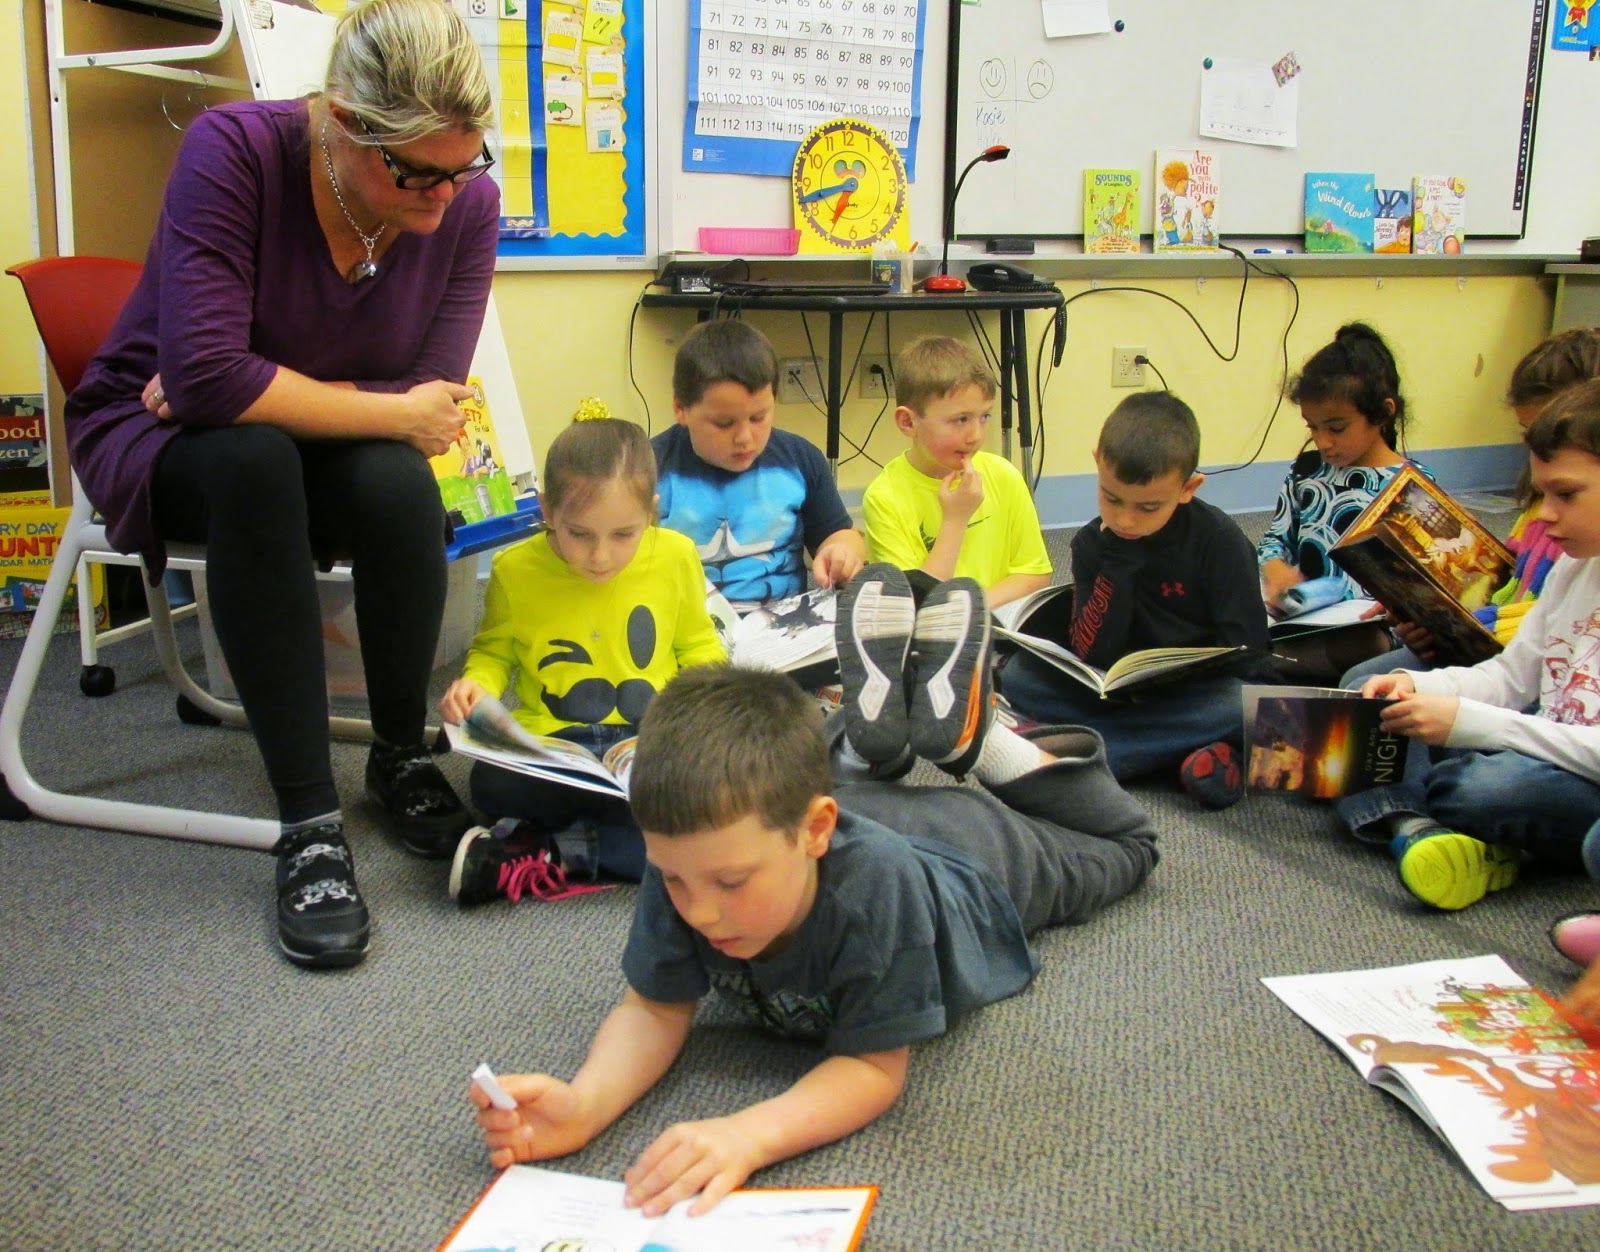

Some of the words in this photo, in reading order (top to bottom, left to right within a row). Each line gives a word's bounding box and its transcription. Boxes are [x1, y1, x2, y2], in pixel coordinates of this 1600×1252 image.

[842, 0, 852, 11] 67
[862, 3, 875, 13] 68
[884, 4, 896, 14] 69
[904, 6, 916, 17] 70
[710, 13, 721, 23] 71
[732, 15, 744, 26] 72
[754, 17, 767, 28] 73
[775, 20, 788, 31] 74
[798, 21, 811, 33] 75
[820, 23, 832, 35] 76
[842, 25, 853, 36] 77
[862, 28, 874, 39] 78
[882, 30, 894, 41] 79
[901, 32, 914, 43] 80
[708, 38, 719, 50] 81
[730, 41, 742, 52] 82
[752, 43, 764, 54] 83
[772, 45, 785, 56] 84
[794, 47, 807, 58] 85
[816, 49, 829, 60] 86
[838, 51, 851, 62] 87
[859, 53, 872, 64] 88
[880, 55, 892, 66] 89
[900, 57, 912, 68] 90
[707, 66, 718, 77] 91
[729, 68, 741, 79] 92
[750, 70, 763, 81] 93
[771, 71, 784, 83] 94
[792, 73, 805, 85] 95
[814, 75, 827, 87] 96
[836, 77, 849, 89] 97
[857, 79, 869, 90] 98
[878, 80, 890, 92] 99
[892, 82, 911, 93] 100
[702, 92, 719, 103] 101
[724, 93, 742, 105] 102
[746, 95, 764, 106] 103
[766, 97, 783, 108] 104
[787, 99, 804, 110] 105
[807, 100, 825, 112] 106
[829, 102, 846, 113] 107
[850, 104, 868, 115] 108
[871, 105, 889, 116] 109
[893, 106, 910, 118] 110
[701, 117, 717, 129] 111
[723, 119, 740, 130] 112
[746, 120, 762, 131] 113
[767, 122, 783, 133] 114
[788, 124, 804, 135] 115
[890, 131, 908, 142] 120
[825, 136, 834, 151] 11
[842, 131, 854, 146] 12
[866, 138, 870, 152] 1
[809, 154, 822, 169] 10
[882, 156, 889, 170] 2
[1193, 150, 1212, 165] Are
[803, 177, 811, 192] 9
[889, 179, 897, 194] 3
[1095, 174, 1132, 186] SOUNDS
[1190, 182, 1218, 197] polite
[1318, 190, 1342, 208] Wind
[811, 200, 819, 216] 8
[883, 202, 891, 216] 4
[1343, 201, 1372, 219] Blows
[849, 225, 857, 240] 6
[870, 219, 878, 233] 5
[0, 523, 21, 536] RY
[26, 522, 58, 535] DAY
[0, 536, 62, 558] UNT
[1374, 731, 1398, 783] NIGH
